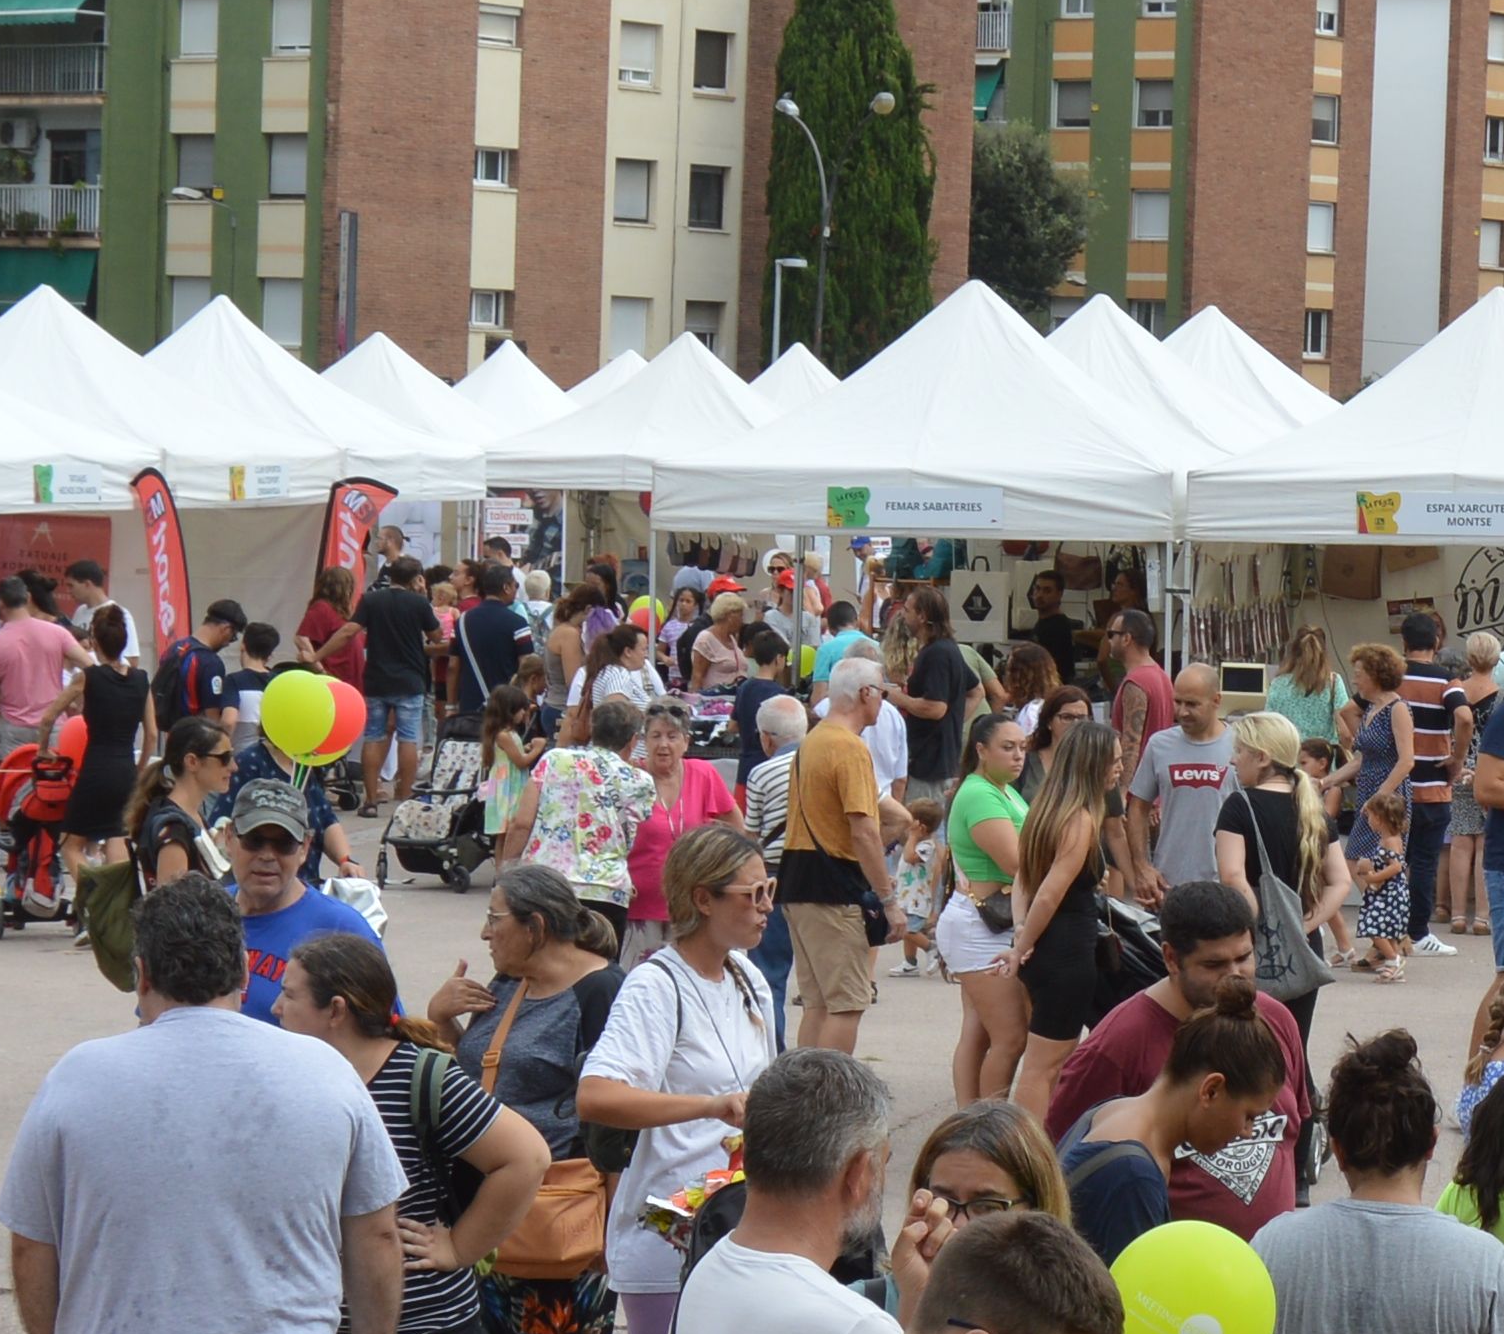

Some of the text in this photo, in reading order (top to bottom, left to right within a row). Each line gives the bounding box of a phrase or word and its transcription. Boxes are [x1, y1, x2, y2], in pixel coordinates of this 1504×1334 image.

[885, 501, 982, 513] FEMAR SABATERIES
[1426, 503, 1456, 514] ESPAI
[1447, 517, 1492, 527] MONTSE
